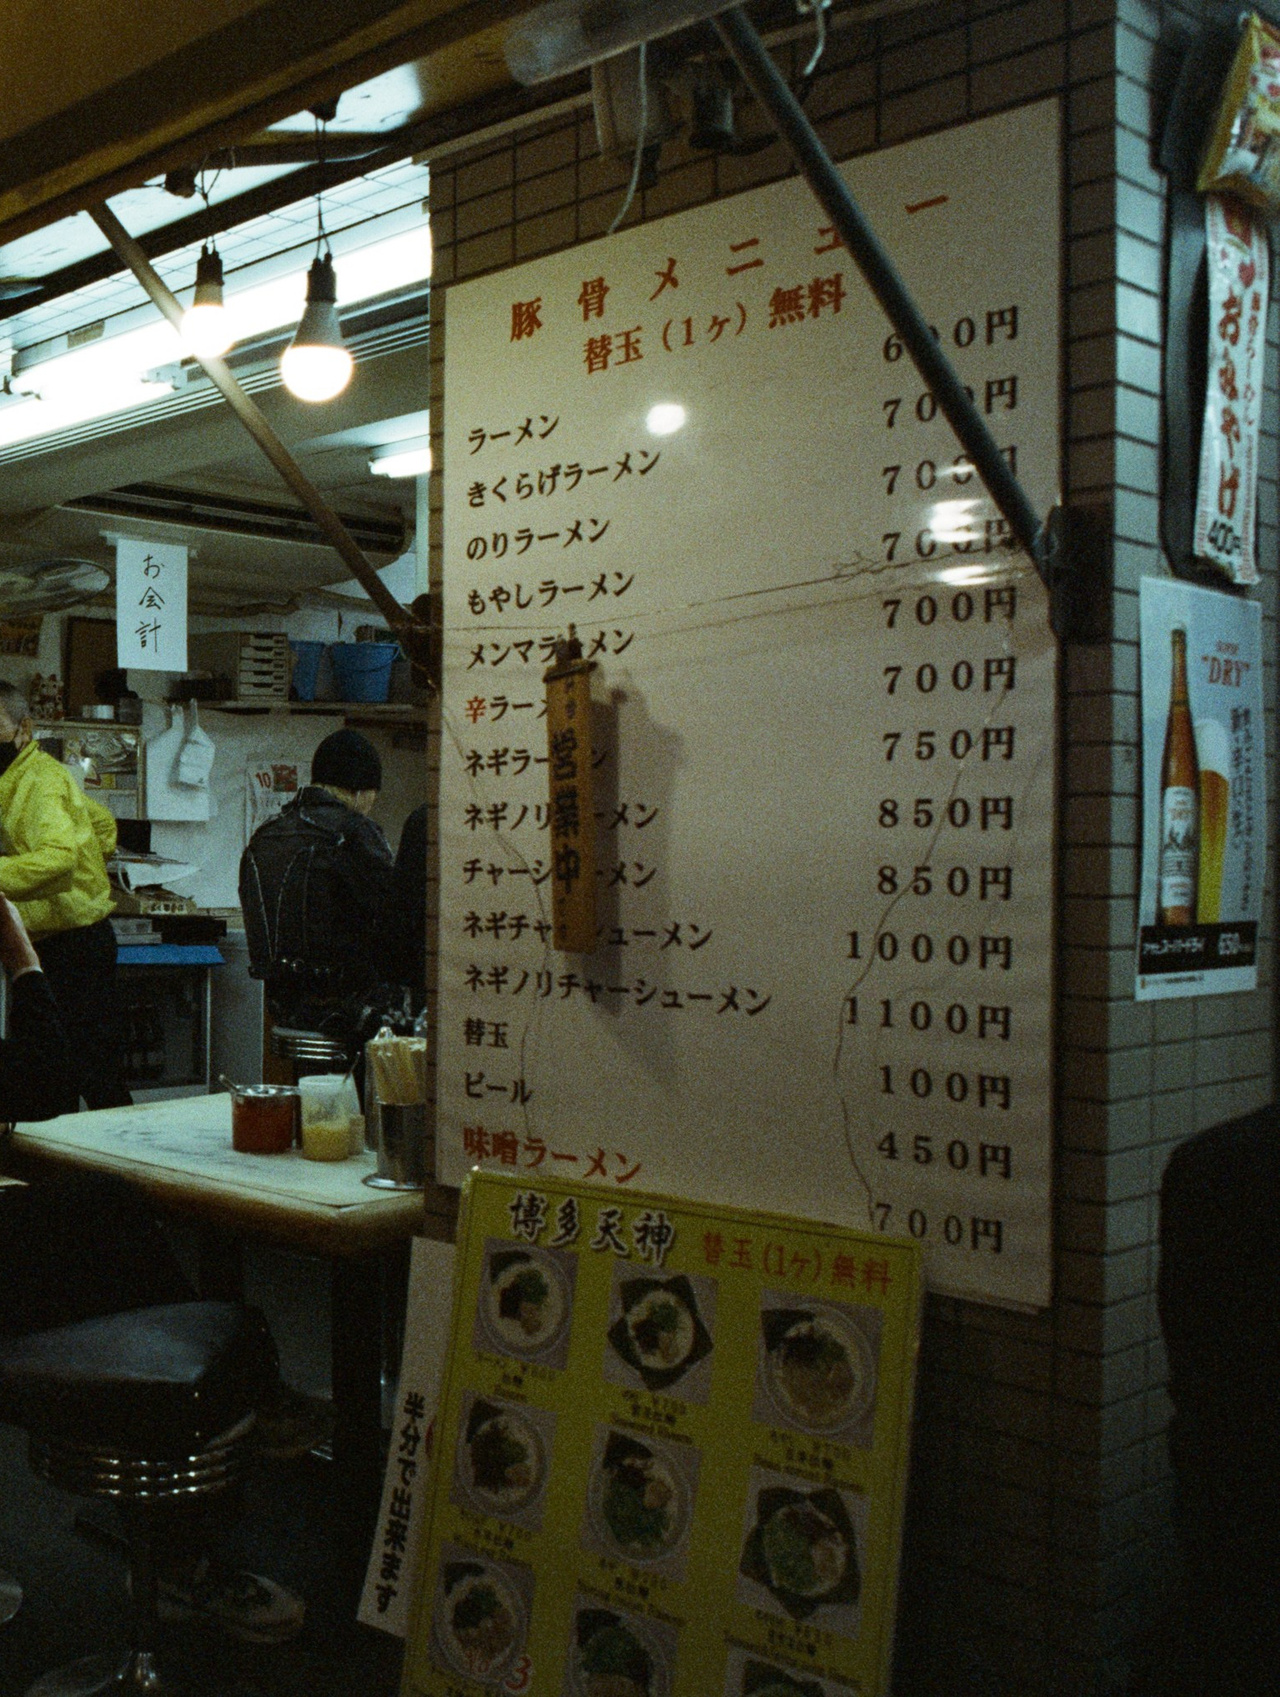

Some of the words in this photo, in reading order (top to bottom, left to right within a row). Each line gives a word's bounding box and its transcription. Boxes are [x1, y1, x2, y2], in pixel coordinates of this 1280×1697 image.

[882, 305, 1020, 364] 60円
[883, 375, 1019, 430] 70円
[467, 415, 560, 456] ラーメン
[467, 450, 662, 508] きくらげラーメン
[467, 517, 611, 561] のりラーメン
[134, 552, 168, 655] お会計
[467, 571, 635, 615] もやしラーメン
[882, 585, 1016, 630] 700円
[467, 629, 635, 670] メンマラメン
[883, 654, 1017, 695] 700円
[465, 695, 549, 724] 辛ラー
[465, 748, 609, 778] ネギラーン
[882, 724, 1016, 763] 750円
[463, 802, 659, 831] ネギノリメン
[878, 795, 1014, 831] 850円
[463, 858, 658, 889] チャーシメン
[877, 865, 1013, 901] 850円
[463, 910, 713, 951] ネギチャューメン
[845, 930, 1013, 971] 1000円
[464, 963, 774, 1017] ネギノリチャーシューメン
[463, 1018, 509, 1050] 替玉
[845, 997, 1012, 1041] 1100円
[880, 1065, 1012, 1111] 100円
[463, 1126, 642, 1184] 味噌ラーメン
[877, 1131, 1012, 1180] 450円
[507, 1192, 677, 1265] 博多天神
[875, 1203, 1004, 1254] 700円
